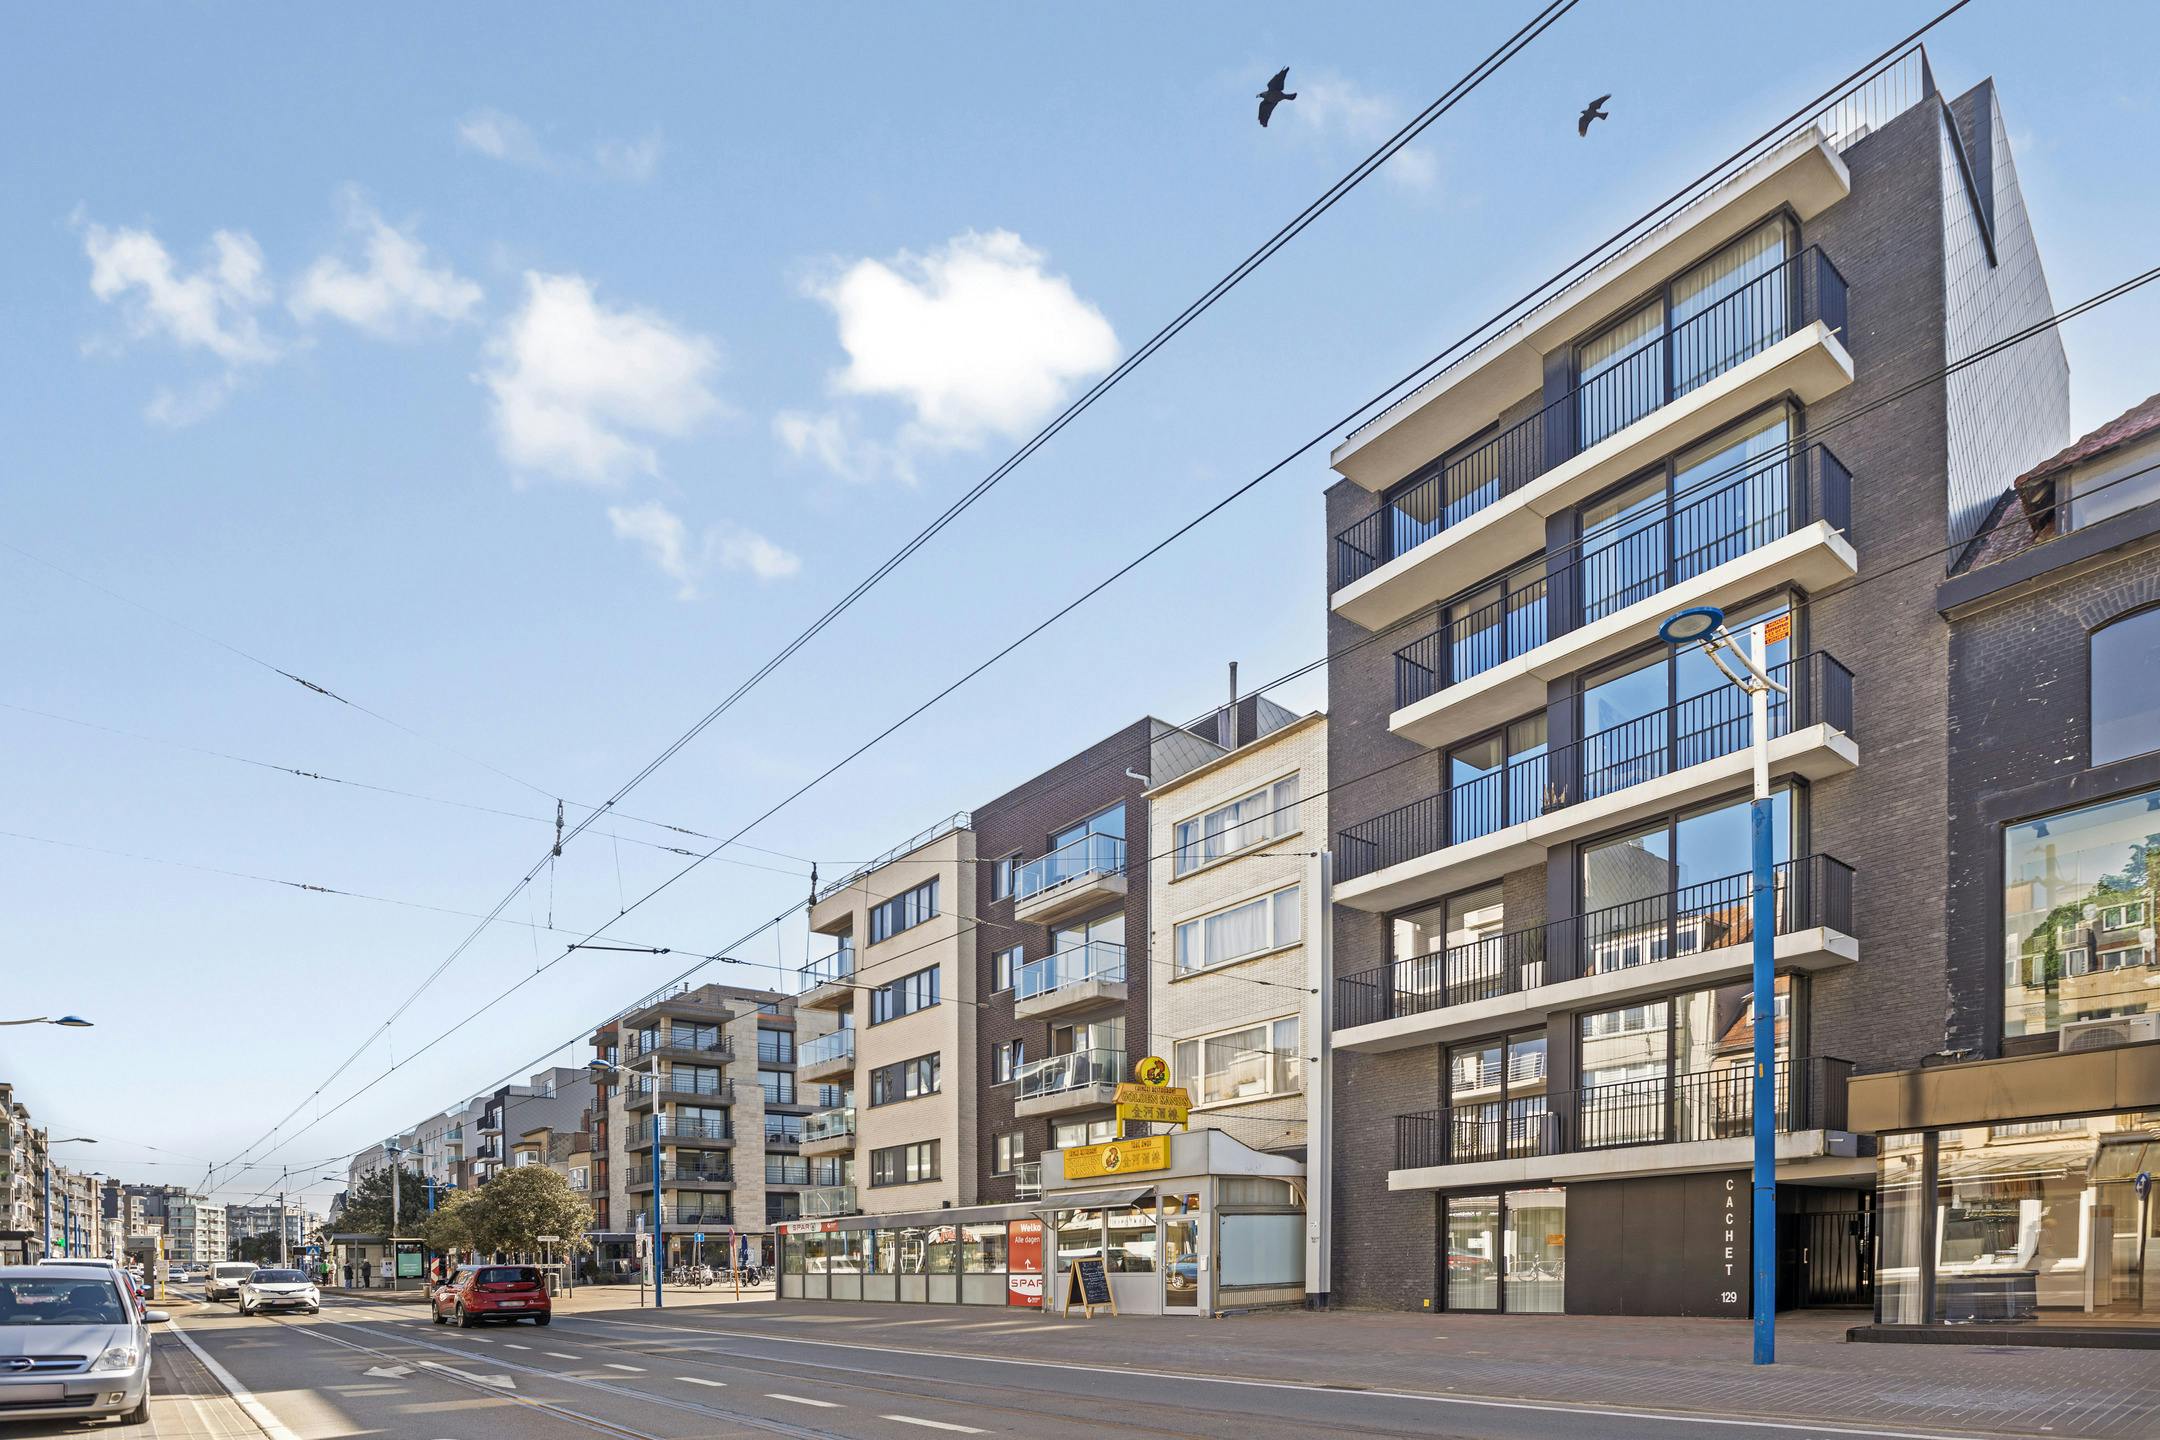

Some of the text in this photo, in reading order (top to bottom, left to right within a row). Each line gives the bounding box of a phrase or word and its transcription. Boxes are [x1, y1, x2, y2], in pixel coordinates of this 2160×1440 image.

[792, 1223, 810, 1231] SPAR
[1021, 1223, 1042, 1232] Welko
[1725, 1179, 1734, 1276] CACHET
[1721, 1291, 1737, 1303] 129
